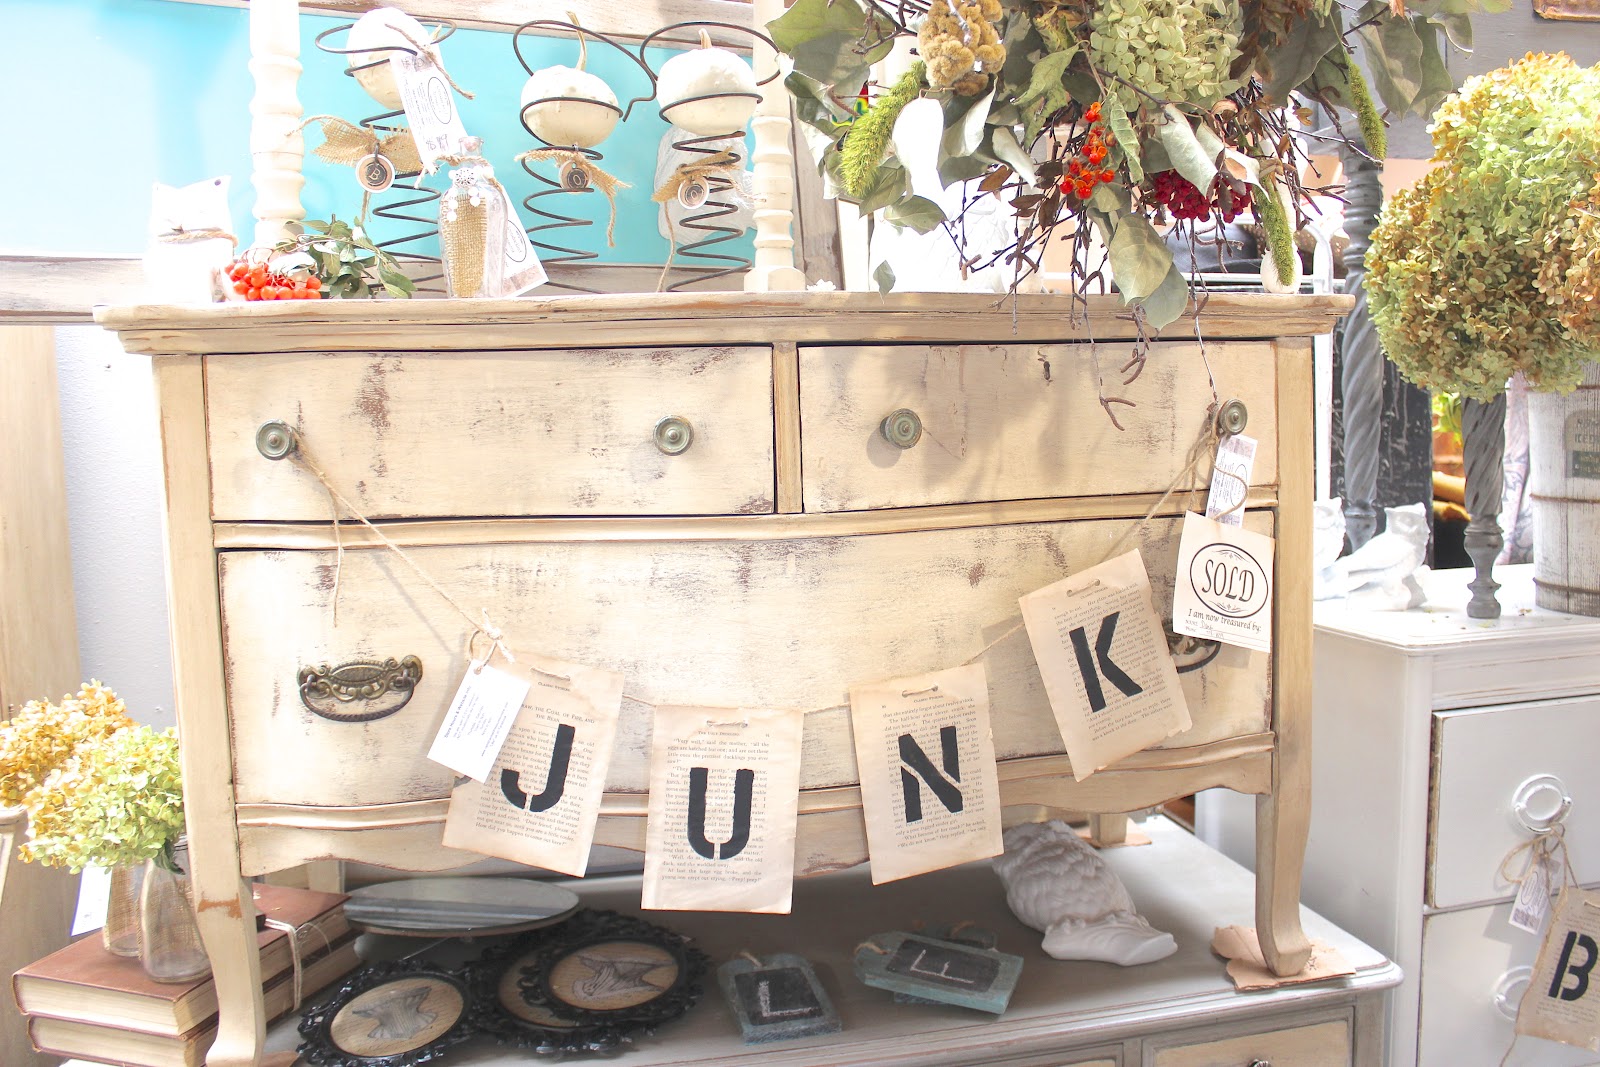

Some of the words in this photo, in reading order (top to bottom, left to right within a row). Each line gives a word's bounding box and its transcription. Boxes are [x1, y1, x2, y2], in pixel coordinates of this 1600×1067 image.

[368, 168, 380, 180] B
[1202, 558, 1255, 602] SOLD
[1188, 608, 1192, 618] I
[1193, 611, 1204, 620] am
[1206, 613, 1220, 623] now
[1220, 614, 1252, 630] treasured
[1068, 611, 1144, 713] K
[501, 723, 576, 813] J
[898, 726, 964, 823] N
[688, 767, 754, 860] U
[757, 980, 814, 1018] L
[1548, 931, 1598, 1001] B
